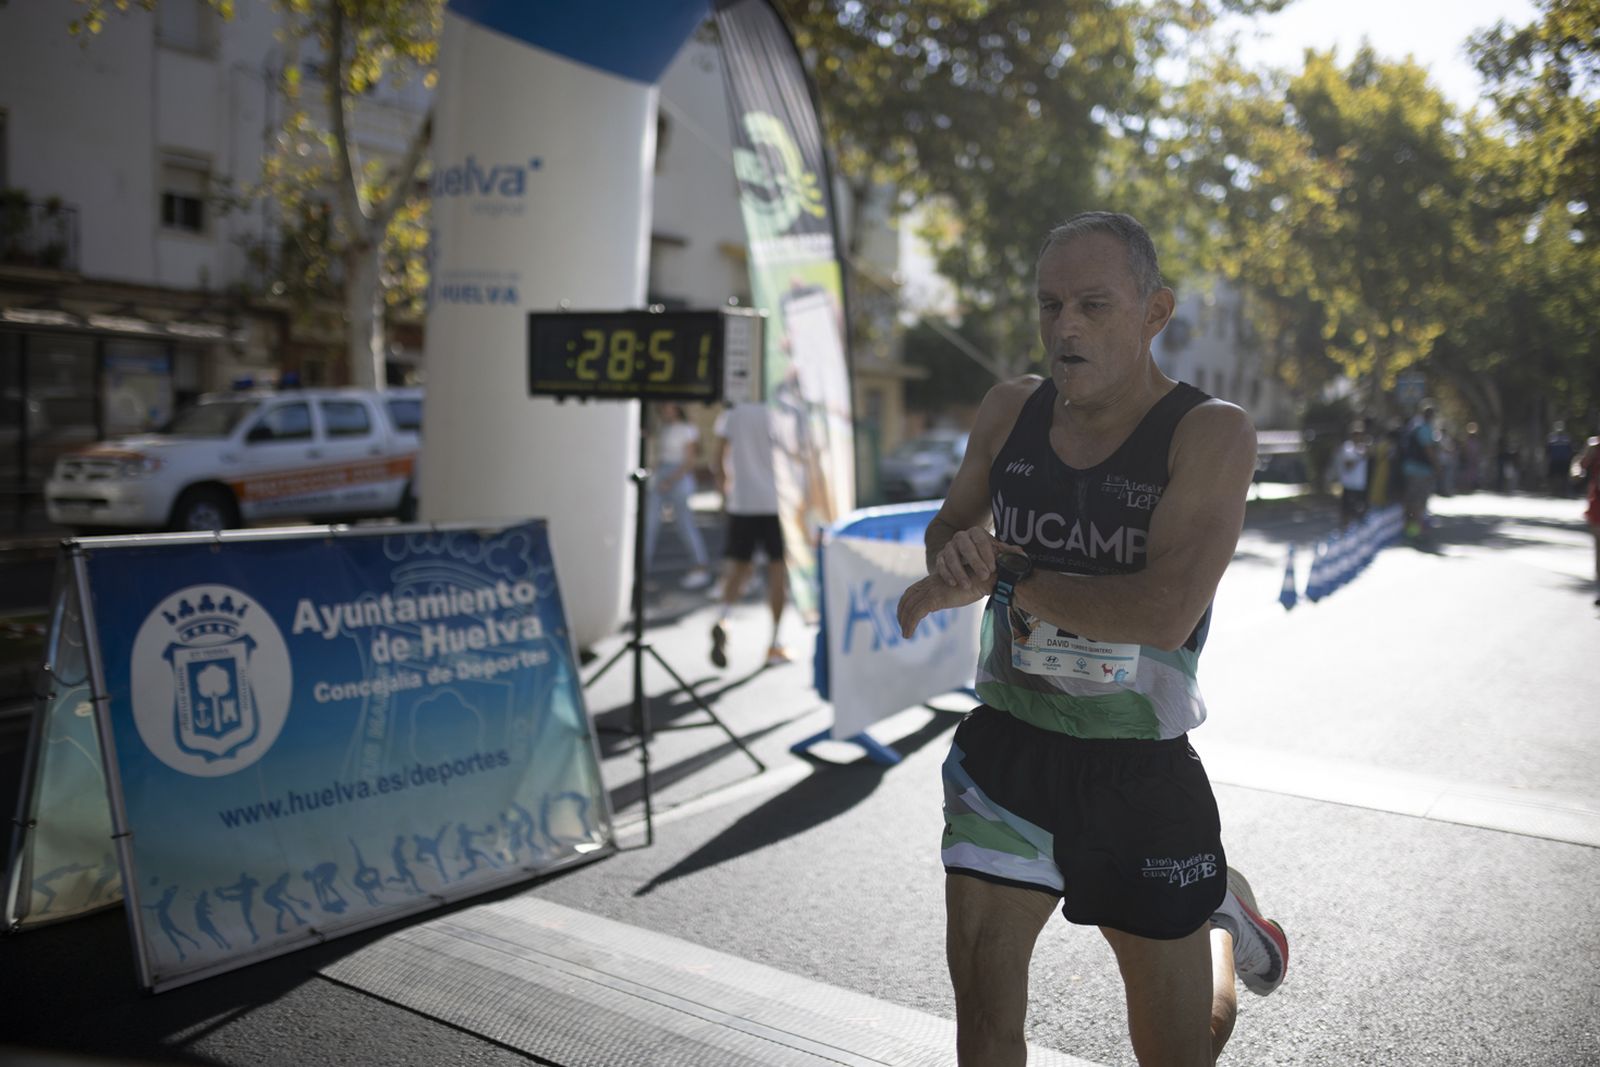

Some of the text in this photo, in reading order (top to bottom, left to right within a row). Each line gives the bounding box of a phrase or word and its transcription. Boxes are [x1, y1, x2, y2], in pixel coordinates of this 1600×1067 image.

[440, 284, 520, 305] HUELVA
[292, 580, 537, 640] Ayuntamiento
[371, 614, 543, 664] de Huelva
[1047, 638, 1069, 649] DAVID
[427, 665, 453, 685] de
[456, 649, 549, 680] Deportes
[219, 748, 511, 828] www.huelva.es/deportes
